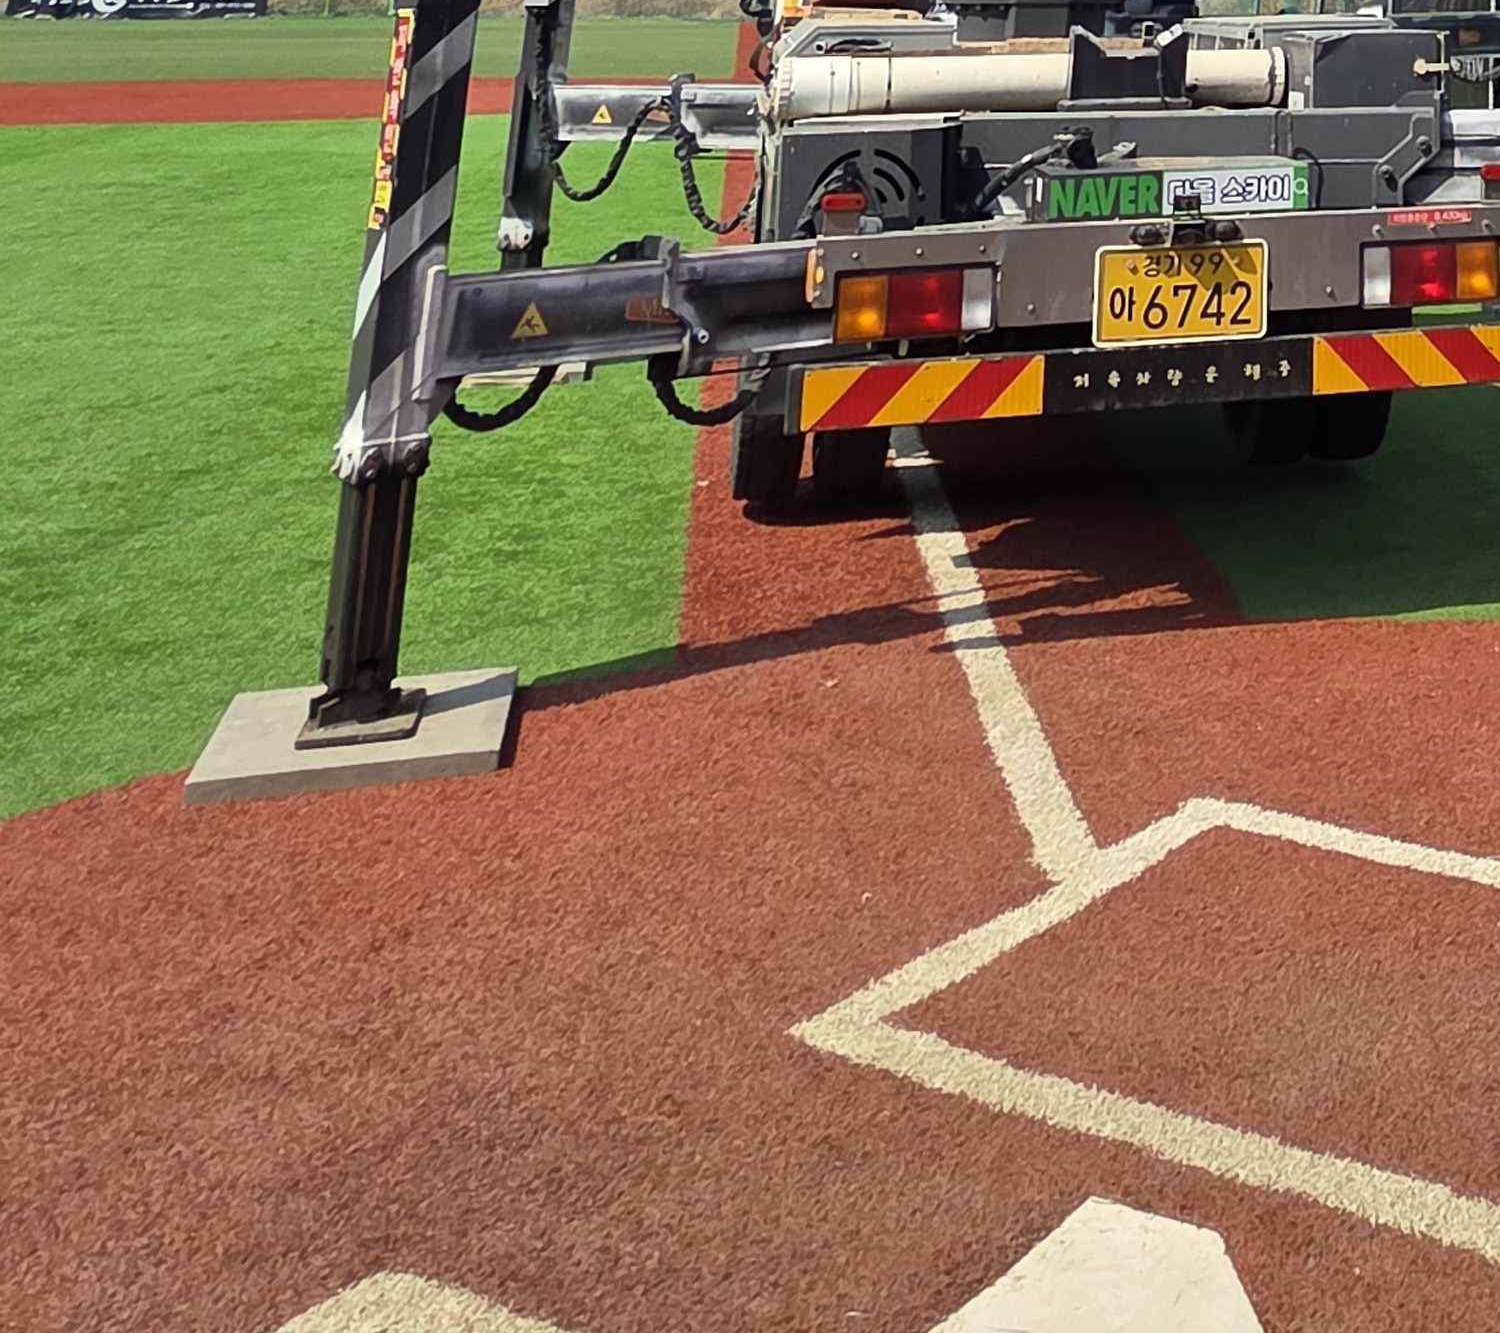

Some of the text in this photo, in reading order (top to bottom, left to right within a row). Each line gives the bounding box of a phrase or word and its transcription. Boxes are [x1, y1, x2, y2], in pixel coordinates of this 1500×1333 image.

[1047, 174, 1160, 220] NAVER
[1220, 173, 1291, 204] 스카이
[1109, 279, 1253, 330] 아6742
